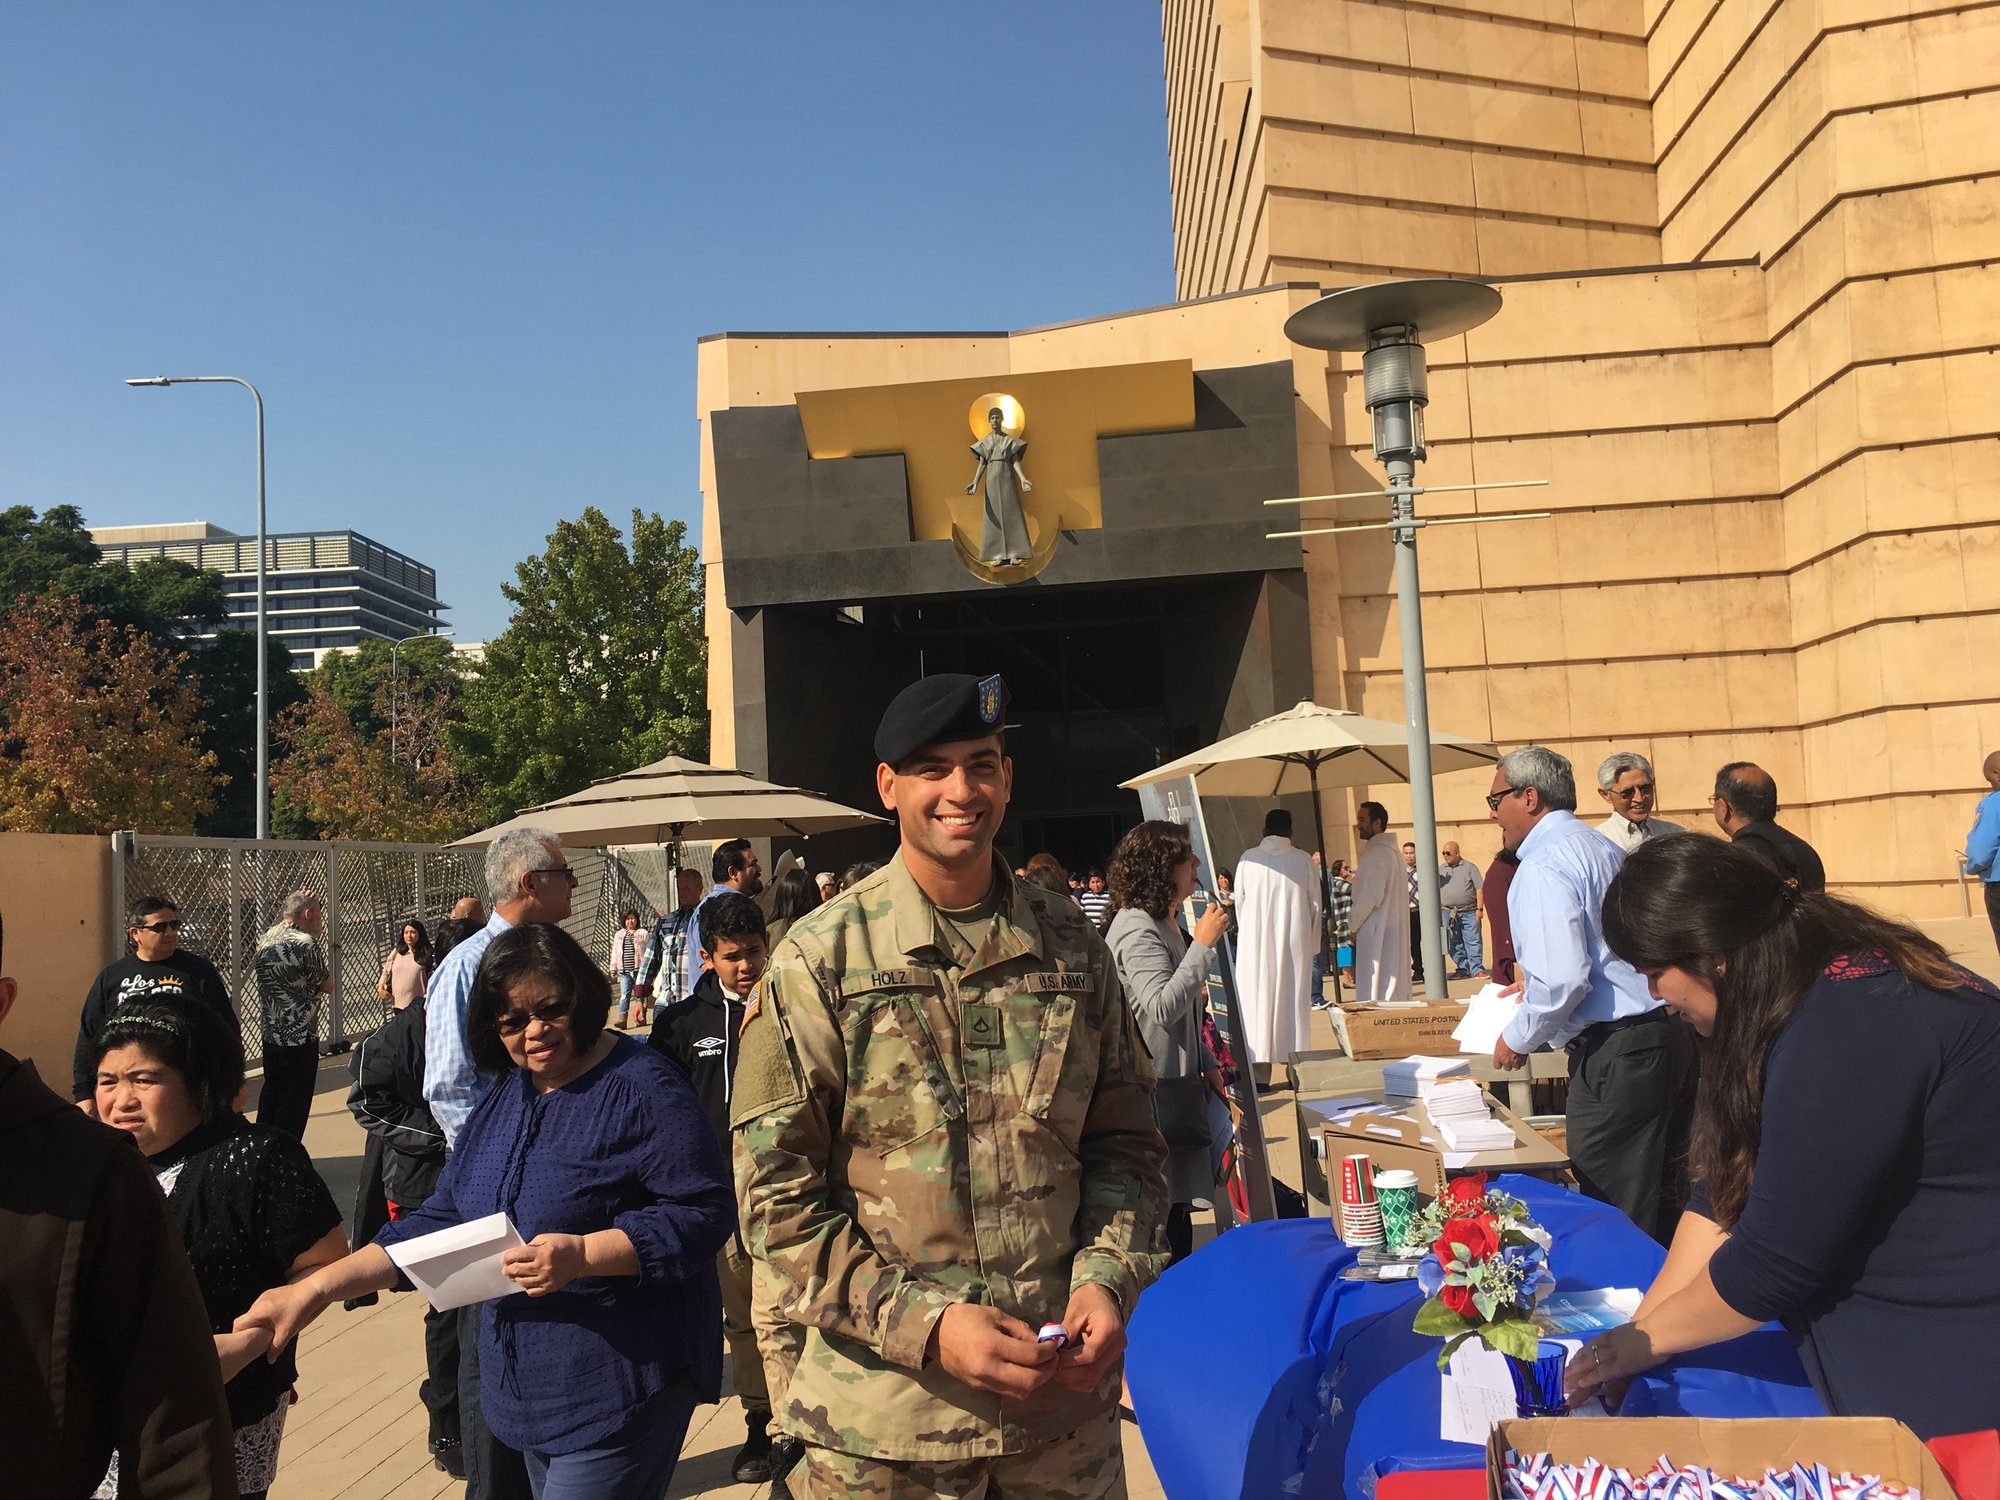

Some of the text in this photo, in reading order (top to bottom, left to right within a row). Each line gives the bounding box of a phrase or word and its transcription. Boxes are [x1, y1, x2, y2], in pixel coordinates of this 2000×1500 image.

[871, 971, 907, 986] HOLZ
[1060, 975, 1086, 989] ARMY
[1373, 1015, 1460, 1026] UNITED STATES POSTAL
[698, 1049, 722, 1057] umbro
